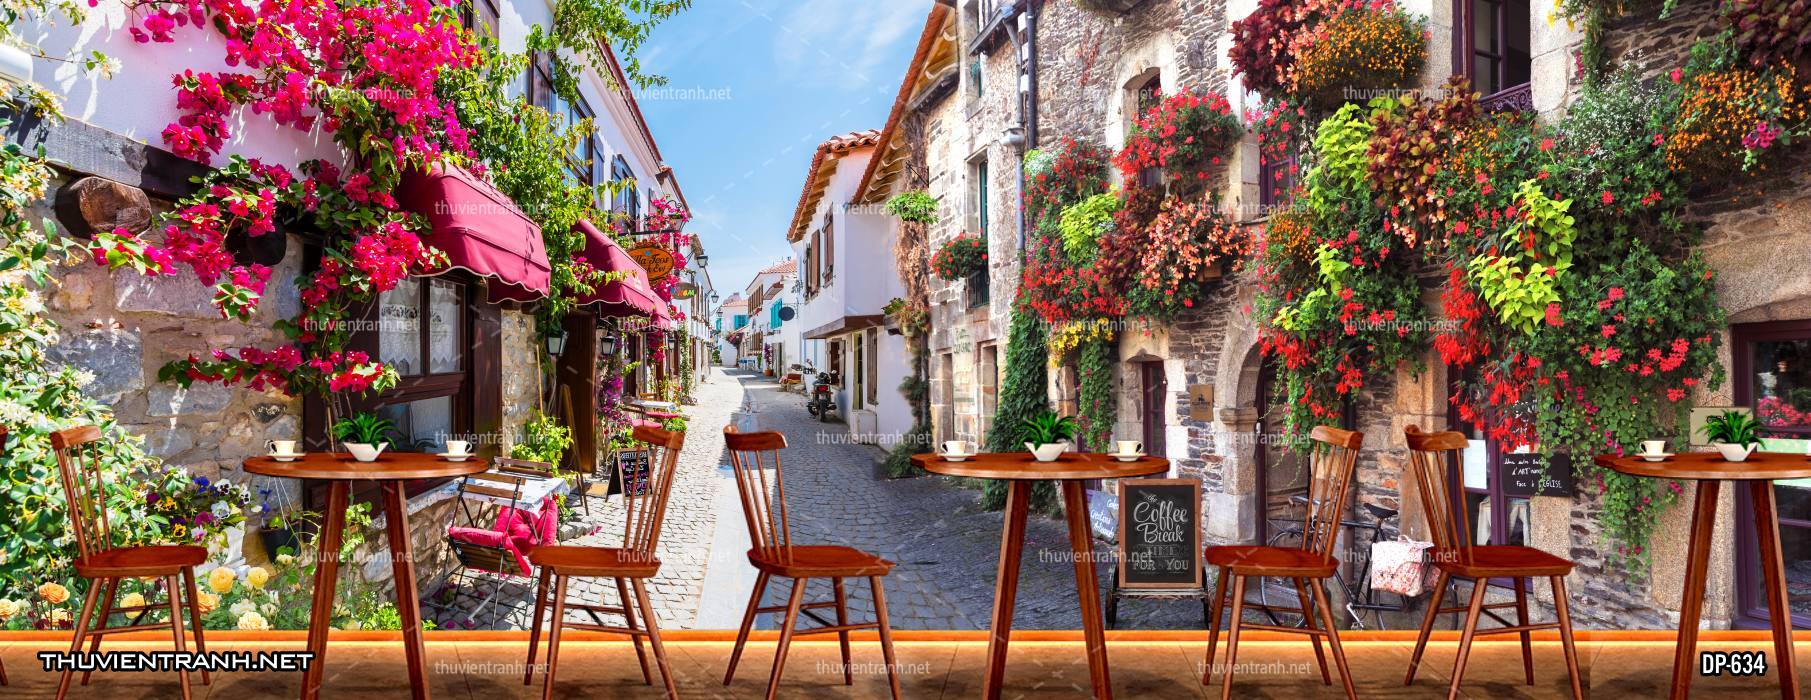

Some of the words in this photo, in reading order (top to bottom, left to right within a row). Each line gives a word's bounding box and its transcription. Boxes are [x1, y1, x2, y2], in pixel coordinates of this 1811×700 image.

[1133, 501, 1188, 532] Coffee
[1136, 522, 1185, 544] Break
[1133, 559, 1156, 571] FOR
[1166, 559, 1189, 571] YOU
